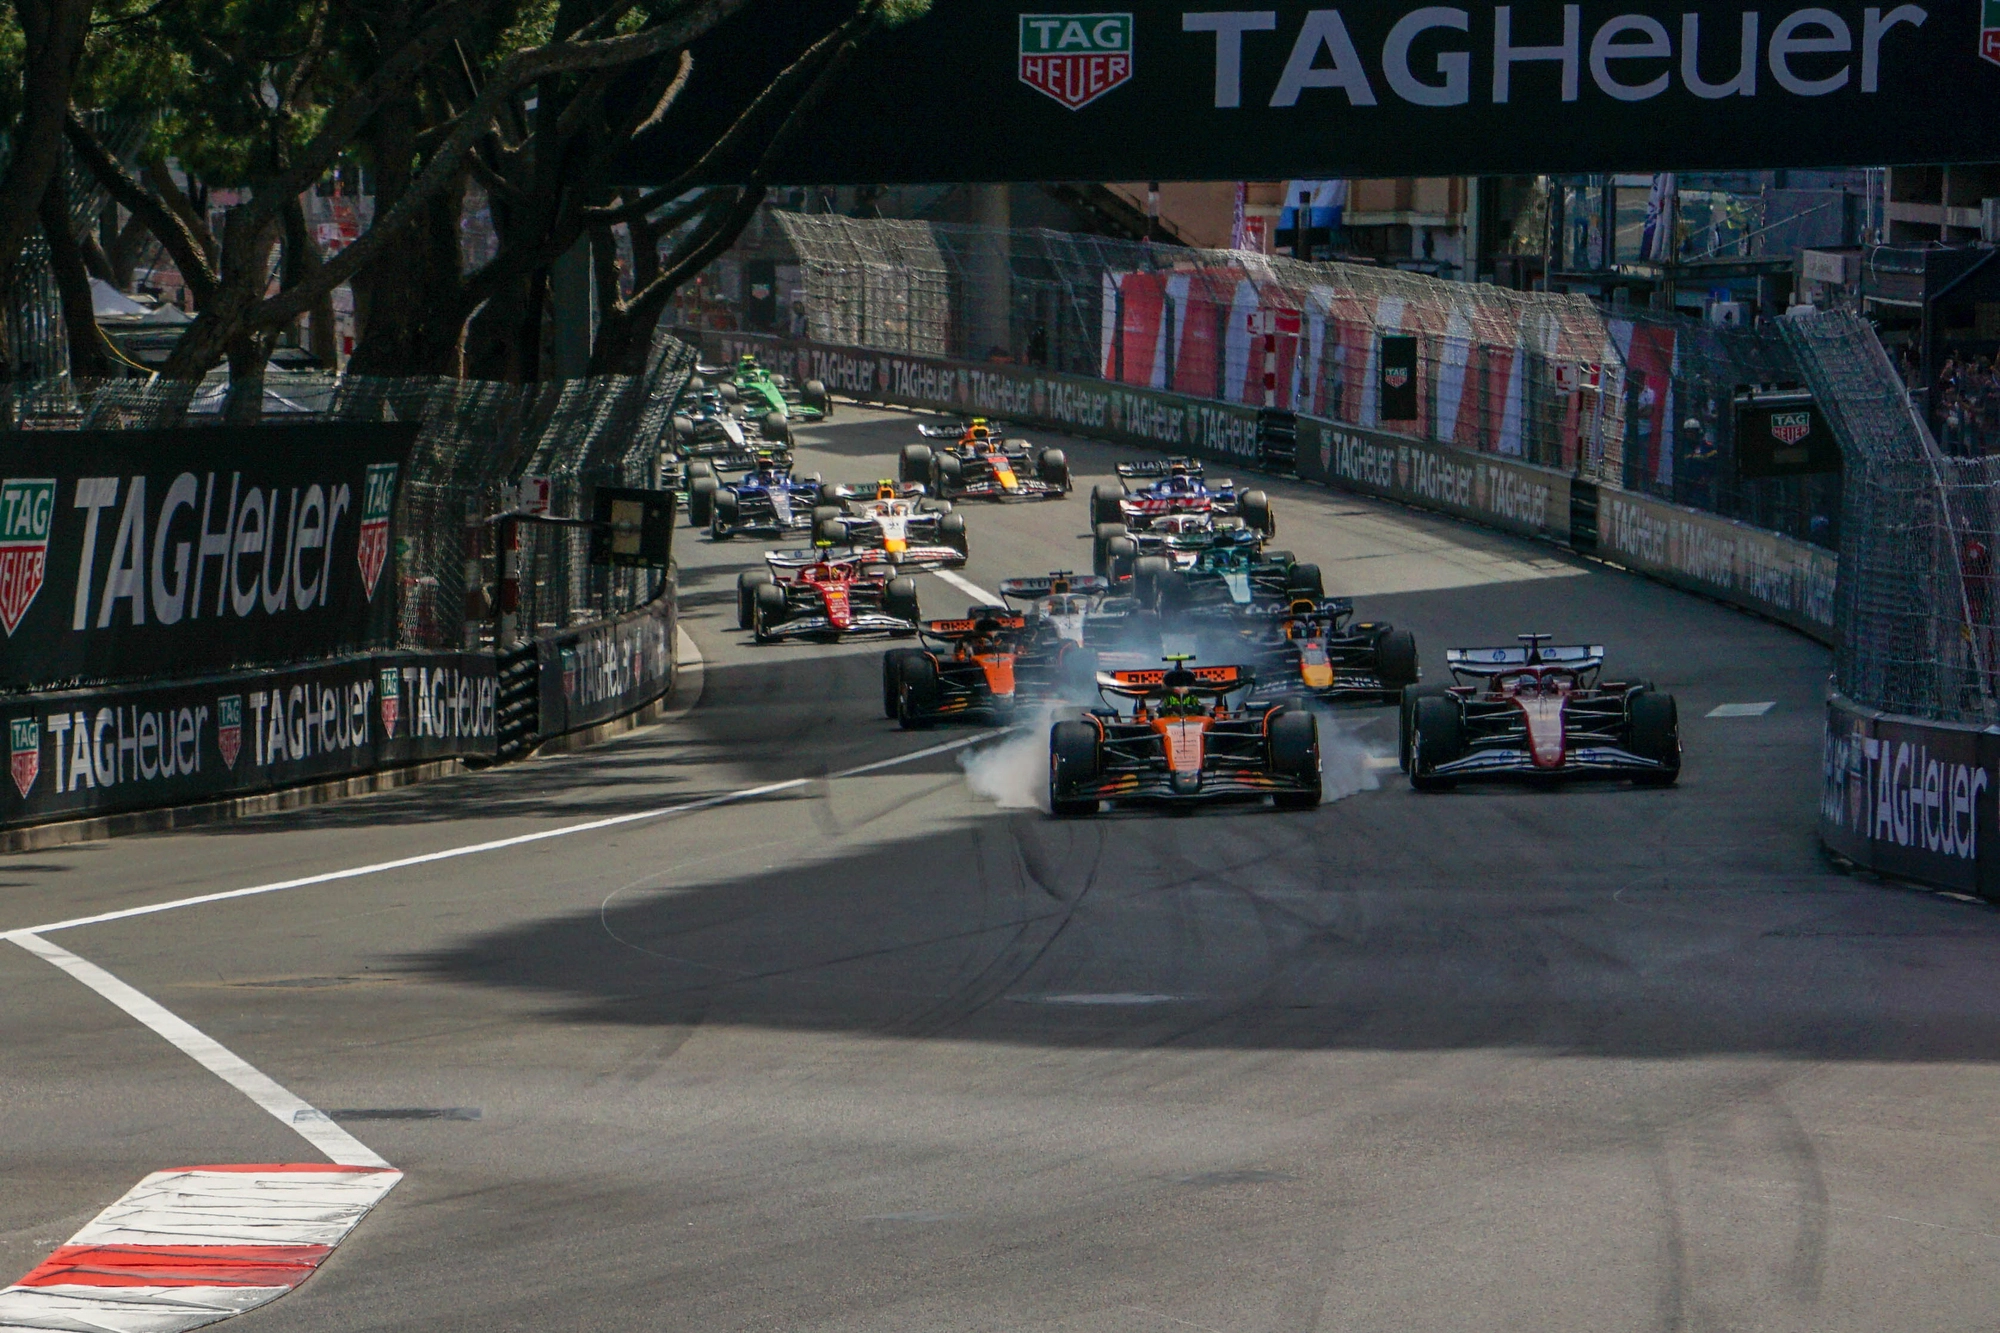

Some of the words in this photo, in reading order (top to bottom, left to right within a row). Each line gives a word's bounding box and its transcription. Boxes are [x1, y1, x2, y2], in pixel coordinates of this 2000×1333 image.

[1029, 20, 1122, 49] TAG
[1026, 57, 1126, 100] HEUER
[1774, 414, 1805, 425] TAG
[366, 472, 393, 515] TAG
[3, 488, 48, 535] TAG
[381, 671, 397, 694] TAG
[220, 701, 240, 724] TAG
[13, 722, 37, 748] TAG
